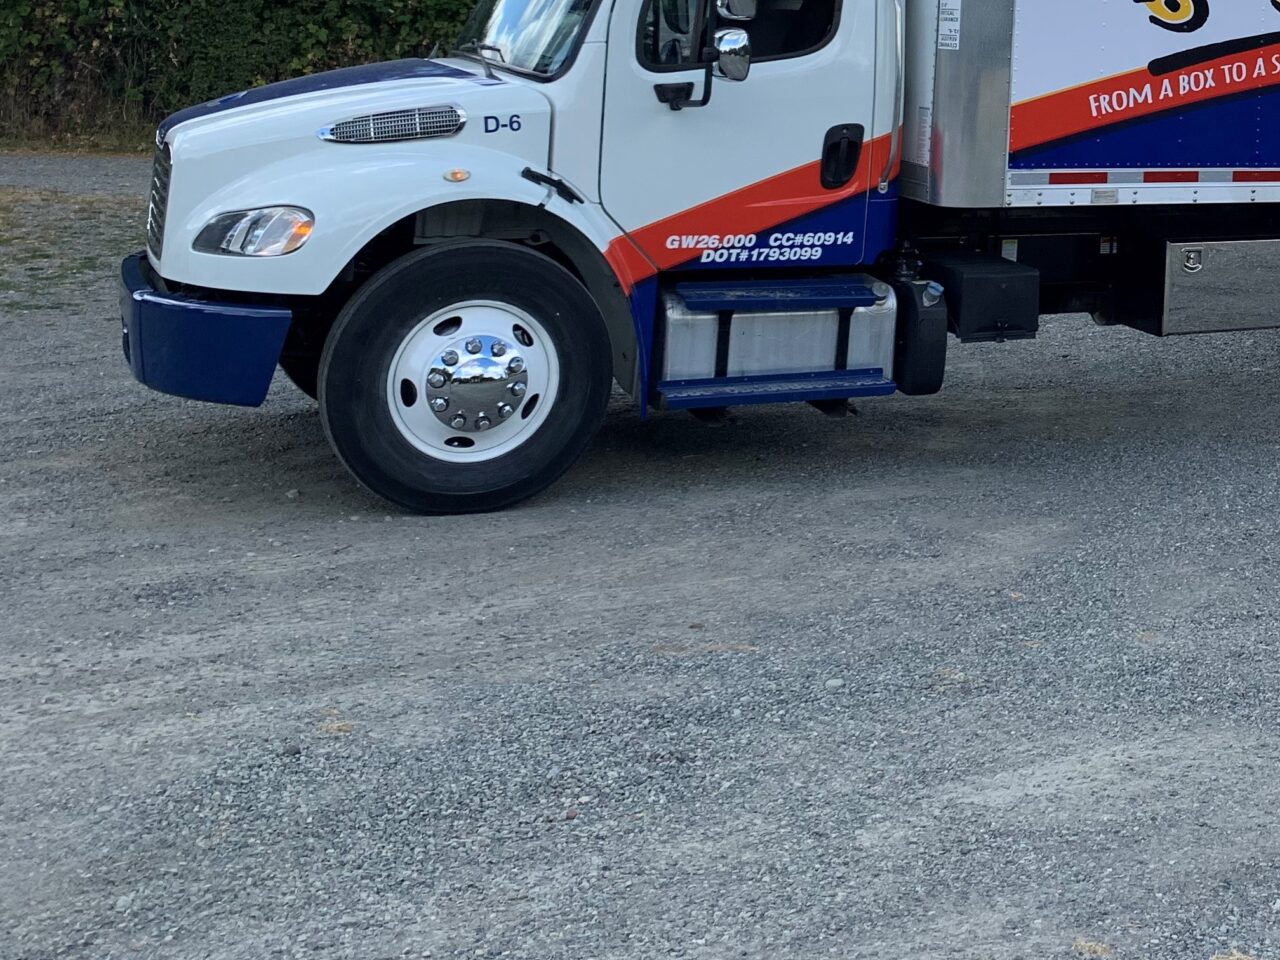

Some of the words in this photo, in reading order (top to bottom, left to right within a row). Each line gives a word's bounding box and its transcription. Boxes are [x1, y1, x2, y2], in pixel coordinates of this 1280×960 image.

[1088, 83, 1153, 117] FROM
[1158, 78, 1174, 100] A
[1178, 67, 1216, 95] BOX
[1221, 62, 1247, 84] TO
[1252, 57, 1266, 79] A
[483, 114, 522, 134] D-6
[665, 233, 757, 250] GW26,000
[768, 231, 854, 247] CC#60914
[700, 246, 823, 263] DOT#1793099
